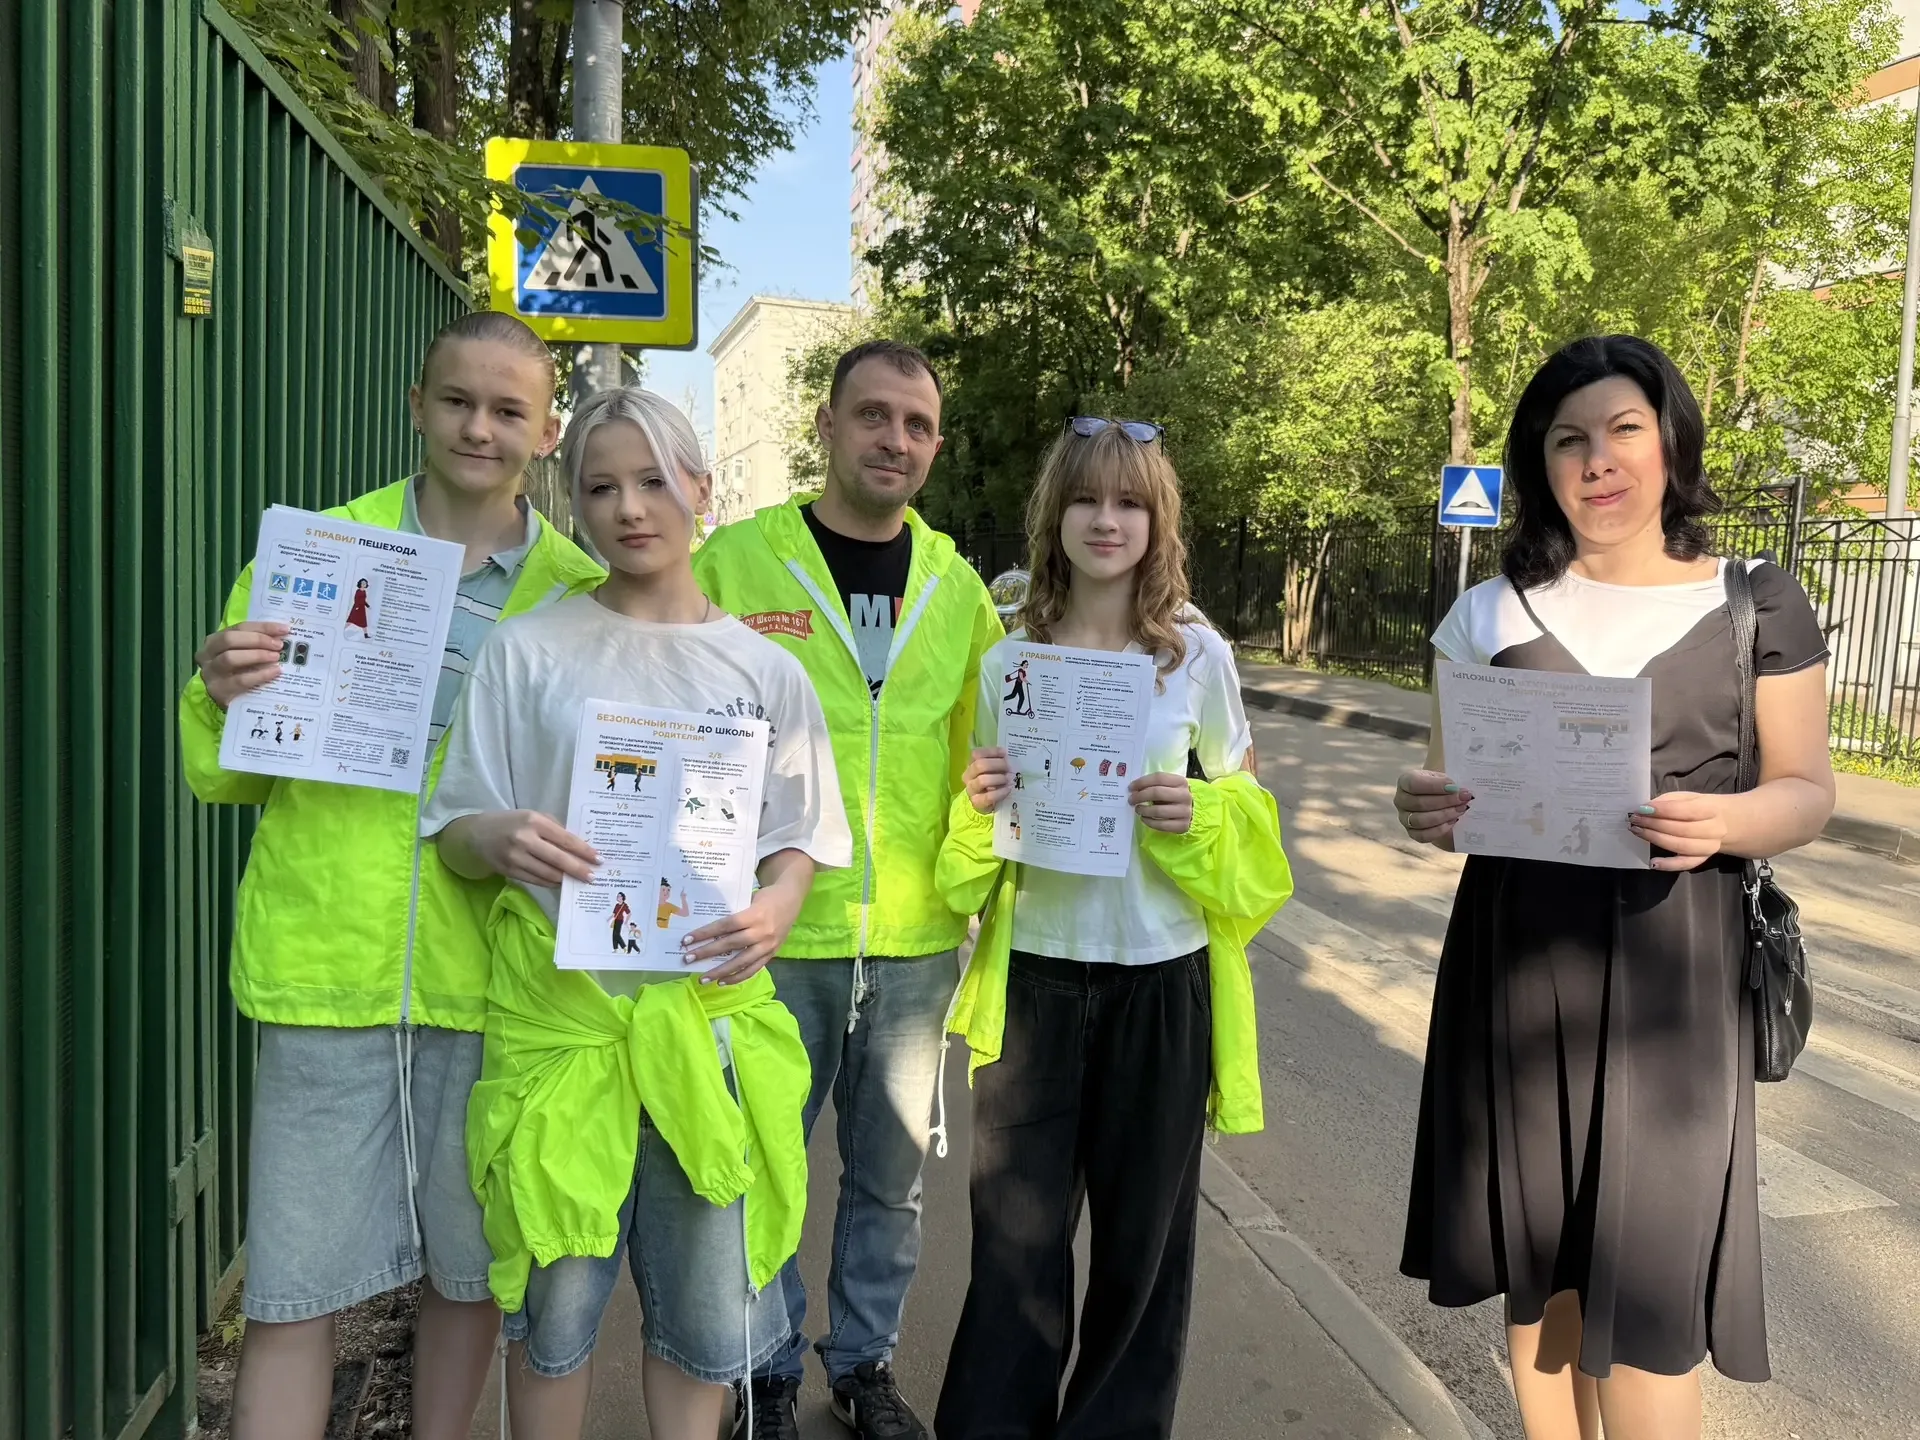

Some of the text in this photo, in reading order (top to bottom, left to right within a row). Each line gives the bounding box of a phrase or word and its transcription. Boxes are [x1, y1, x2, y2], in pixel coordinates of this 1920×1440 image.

[313, 529, 356, 544] ПРАВИЛ
[358, 537, 417, 557] ПЕШЕХОДА
[757, 615, 780, 624] Школа
[1025, 651, 1062, 662] ПРАВИЛА
[596, 711, 666, 728] БЕЗОПАСНЫЙ
[669, 721, 695, 731] ПУТЬ
[715, 726, 753, 738] ШКОЛЫ
[652, 730, 704, 741] РОДИТЕЛЯМ
